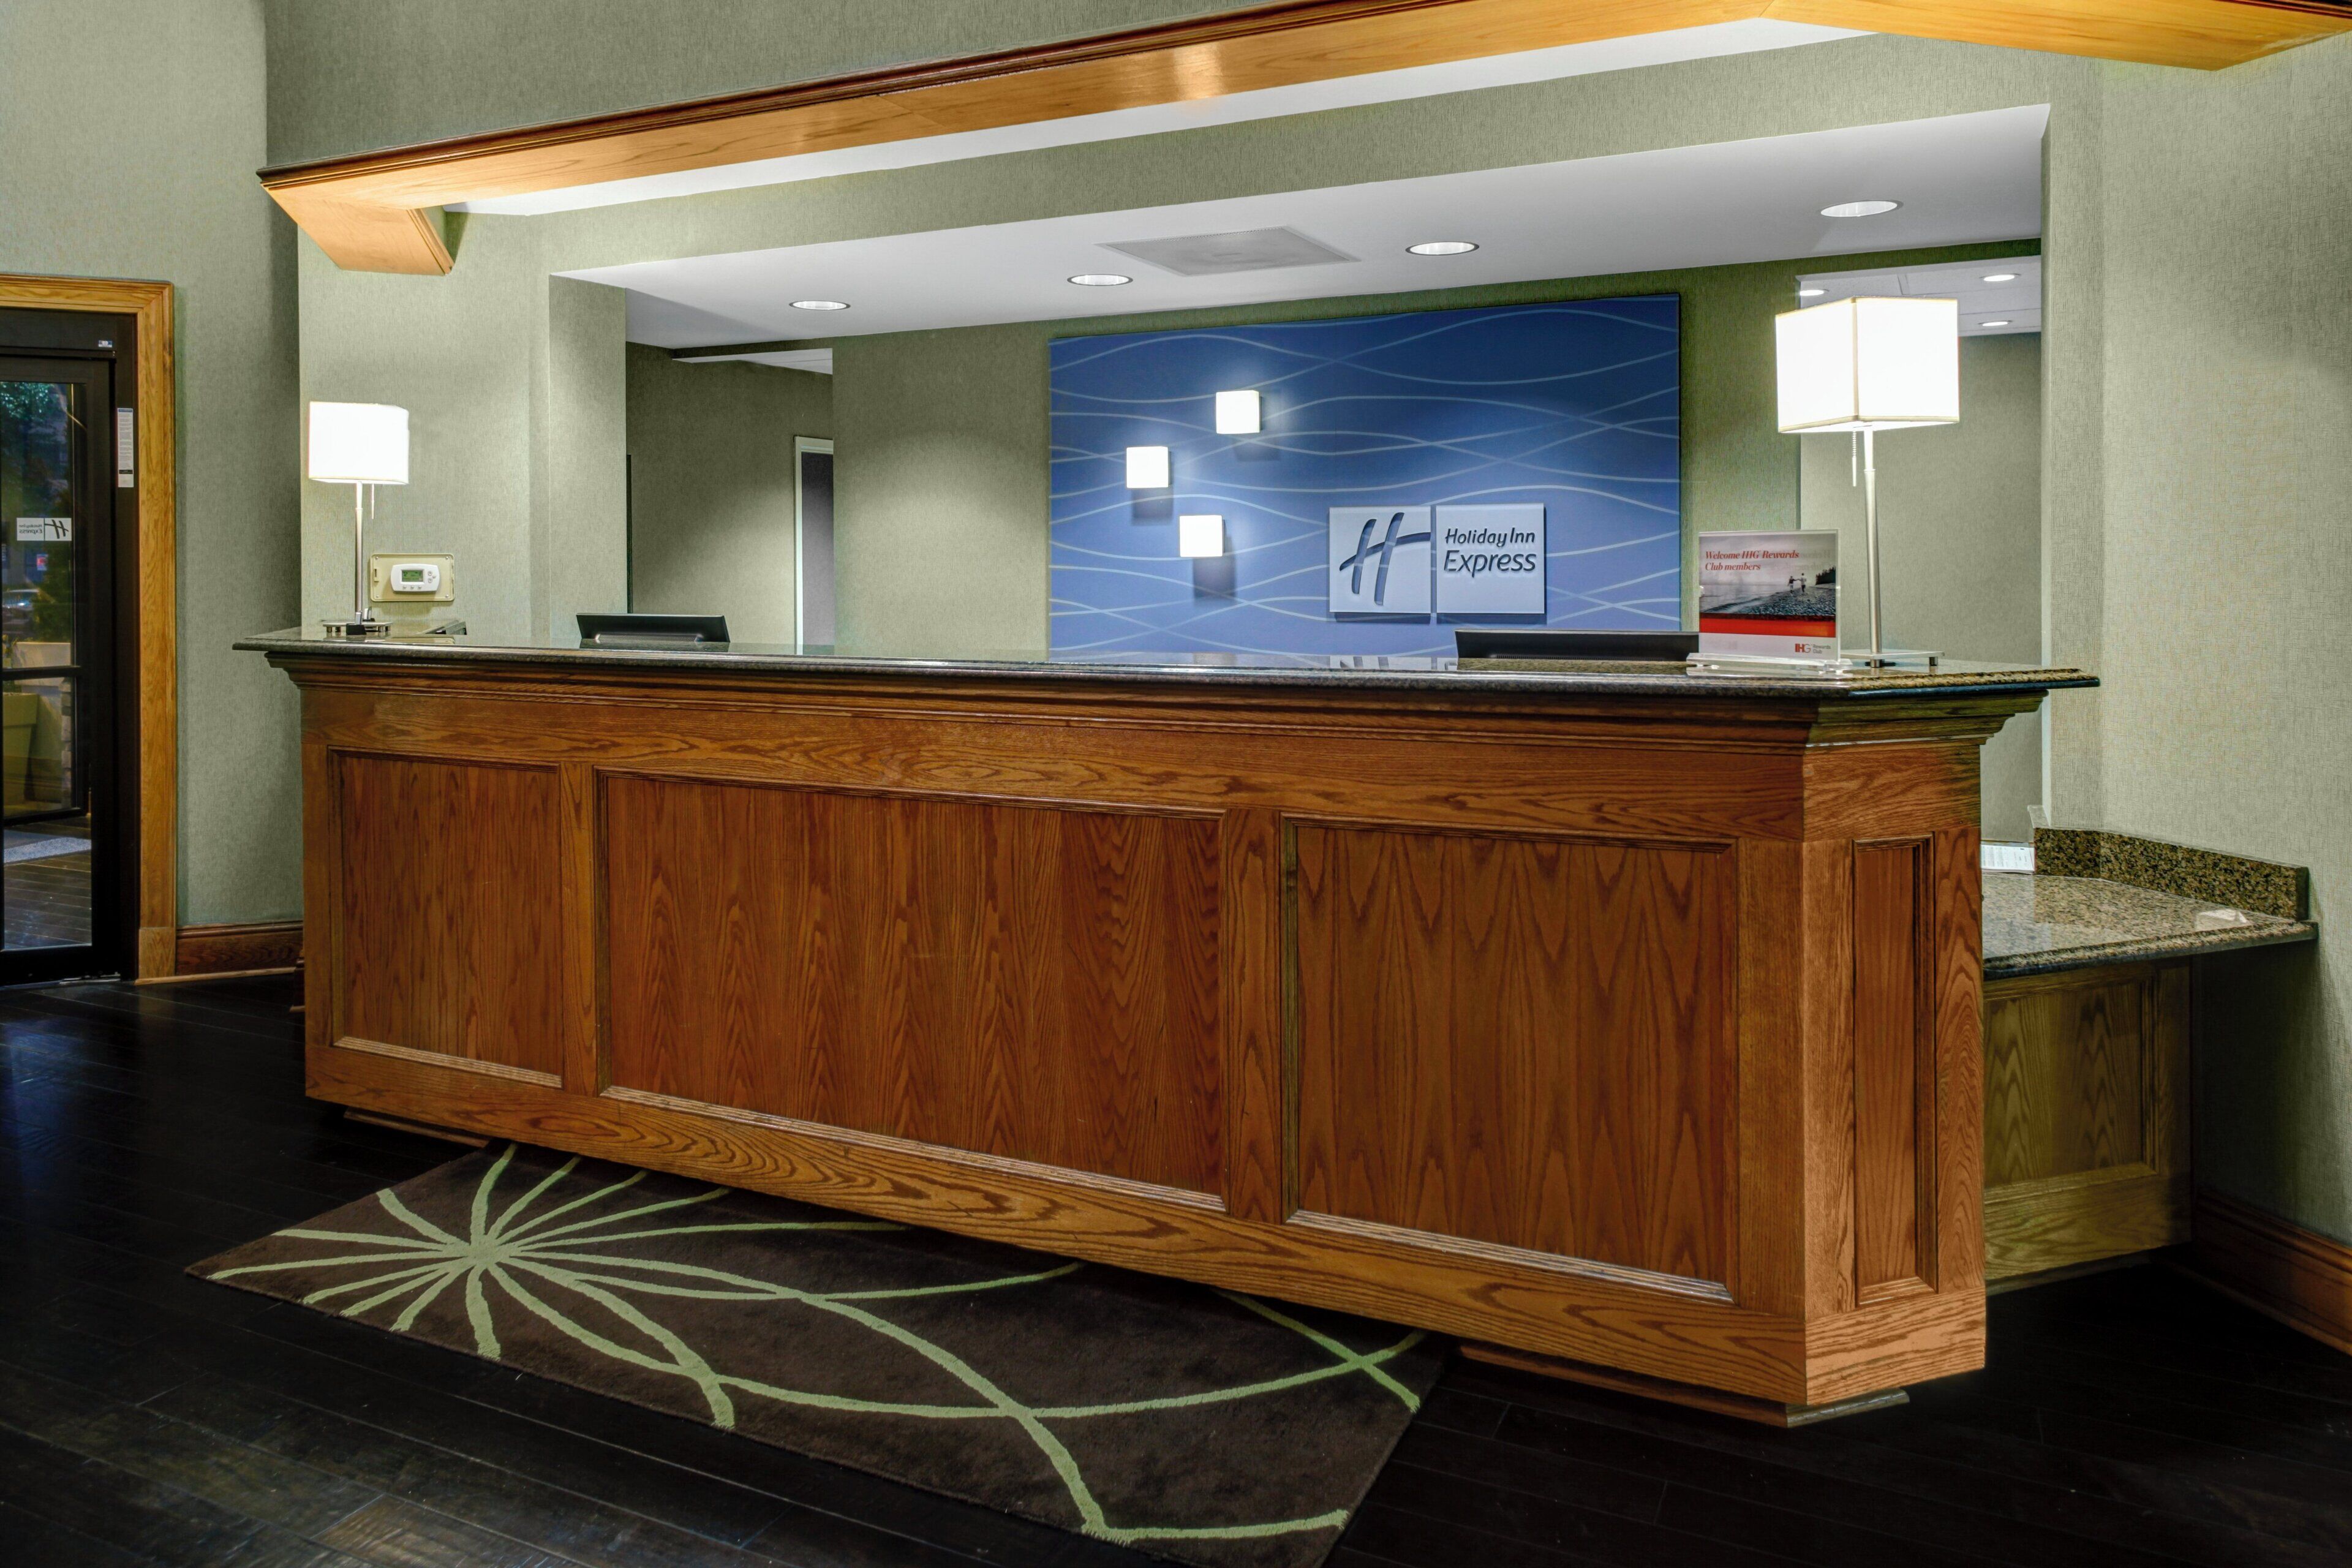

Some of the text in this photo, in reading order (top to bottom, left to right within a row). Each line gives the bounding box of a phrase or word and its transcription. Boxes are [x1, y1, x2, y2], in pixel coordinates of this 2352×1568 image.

[1445, 527, 1536, 548] Holiday Inn
[1762, 550, 1800, 559] Rewards
[1444, 550, 1537, 578] Express
[1795, 643, 1811, 653] IHG
